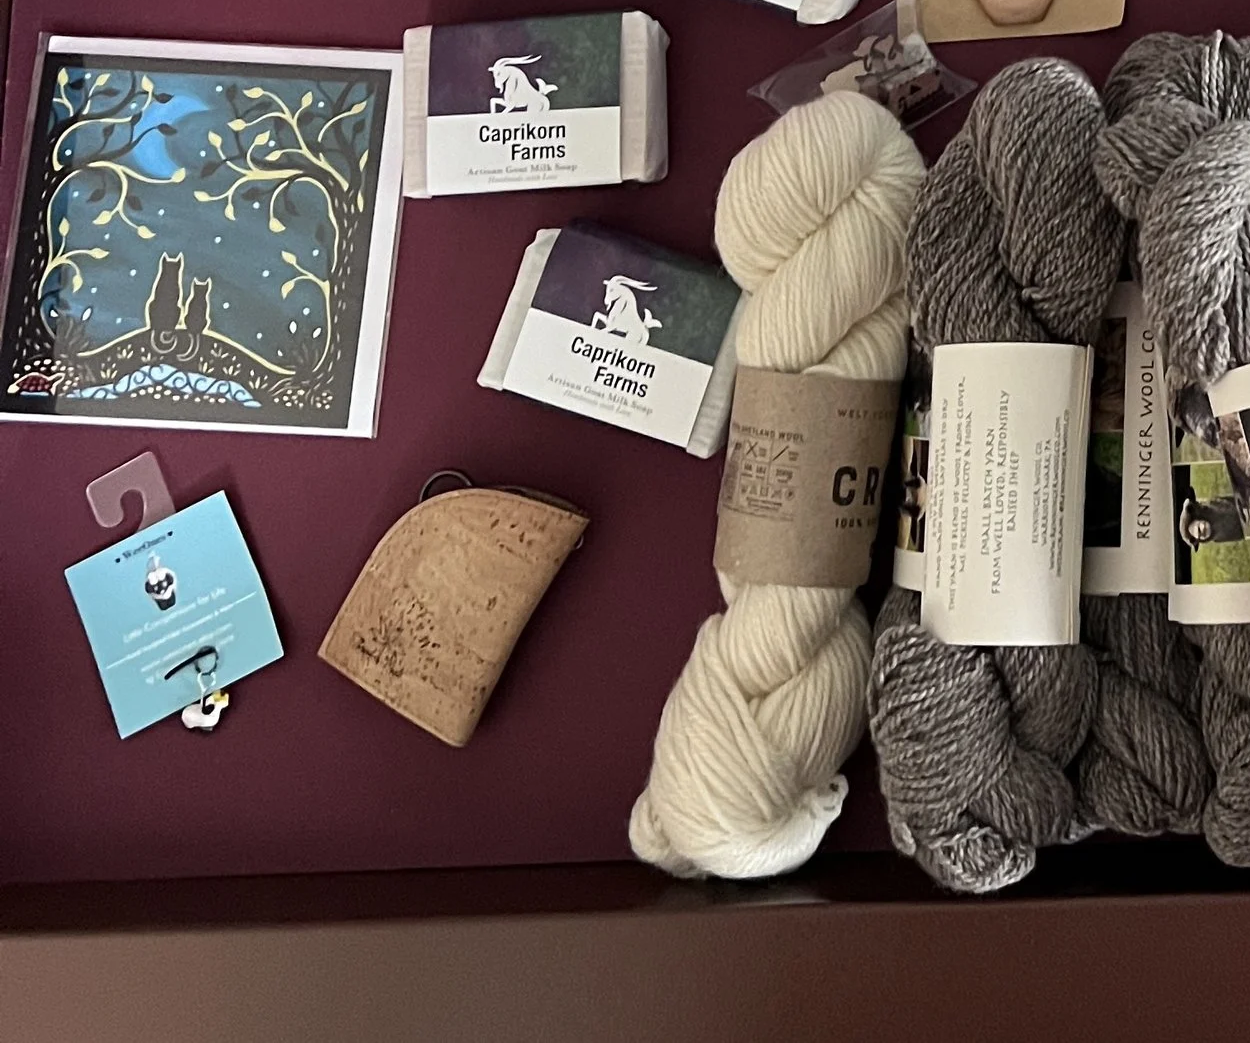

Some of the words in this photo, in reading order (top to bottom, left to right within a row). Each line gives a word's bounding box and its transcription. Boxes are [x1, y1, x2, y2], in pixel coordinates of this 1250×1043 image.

[480, 124, 566, 145] Caprikorn
[511, 143, 566, 161] Farms
[571, 336, 656, 379] Caprikorn
[594, 366, 648, 398] Farms
[1140, 360, 1154, 422] WOOL
[984, 428, 995, 465] YARN
[1136, 423, 1154, 540] RENNINGER
[992, 518, 1004, 553] WELL
[990, 556, 1001, 594] FROM
